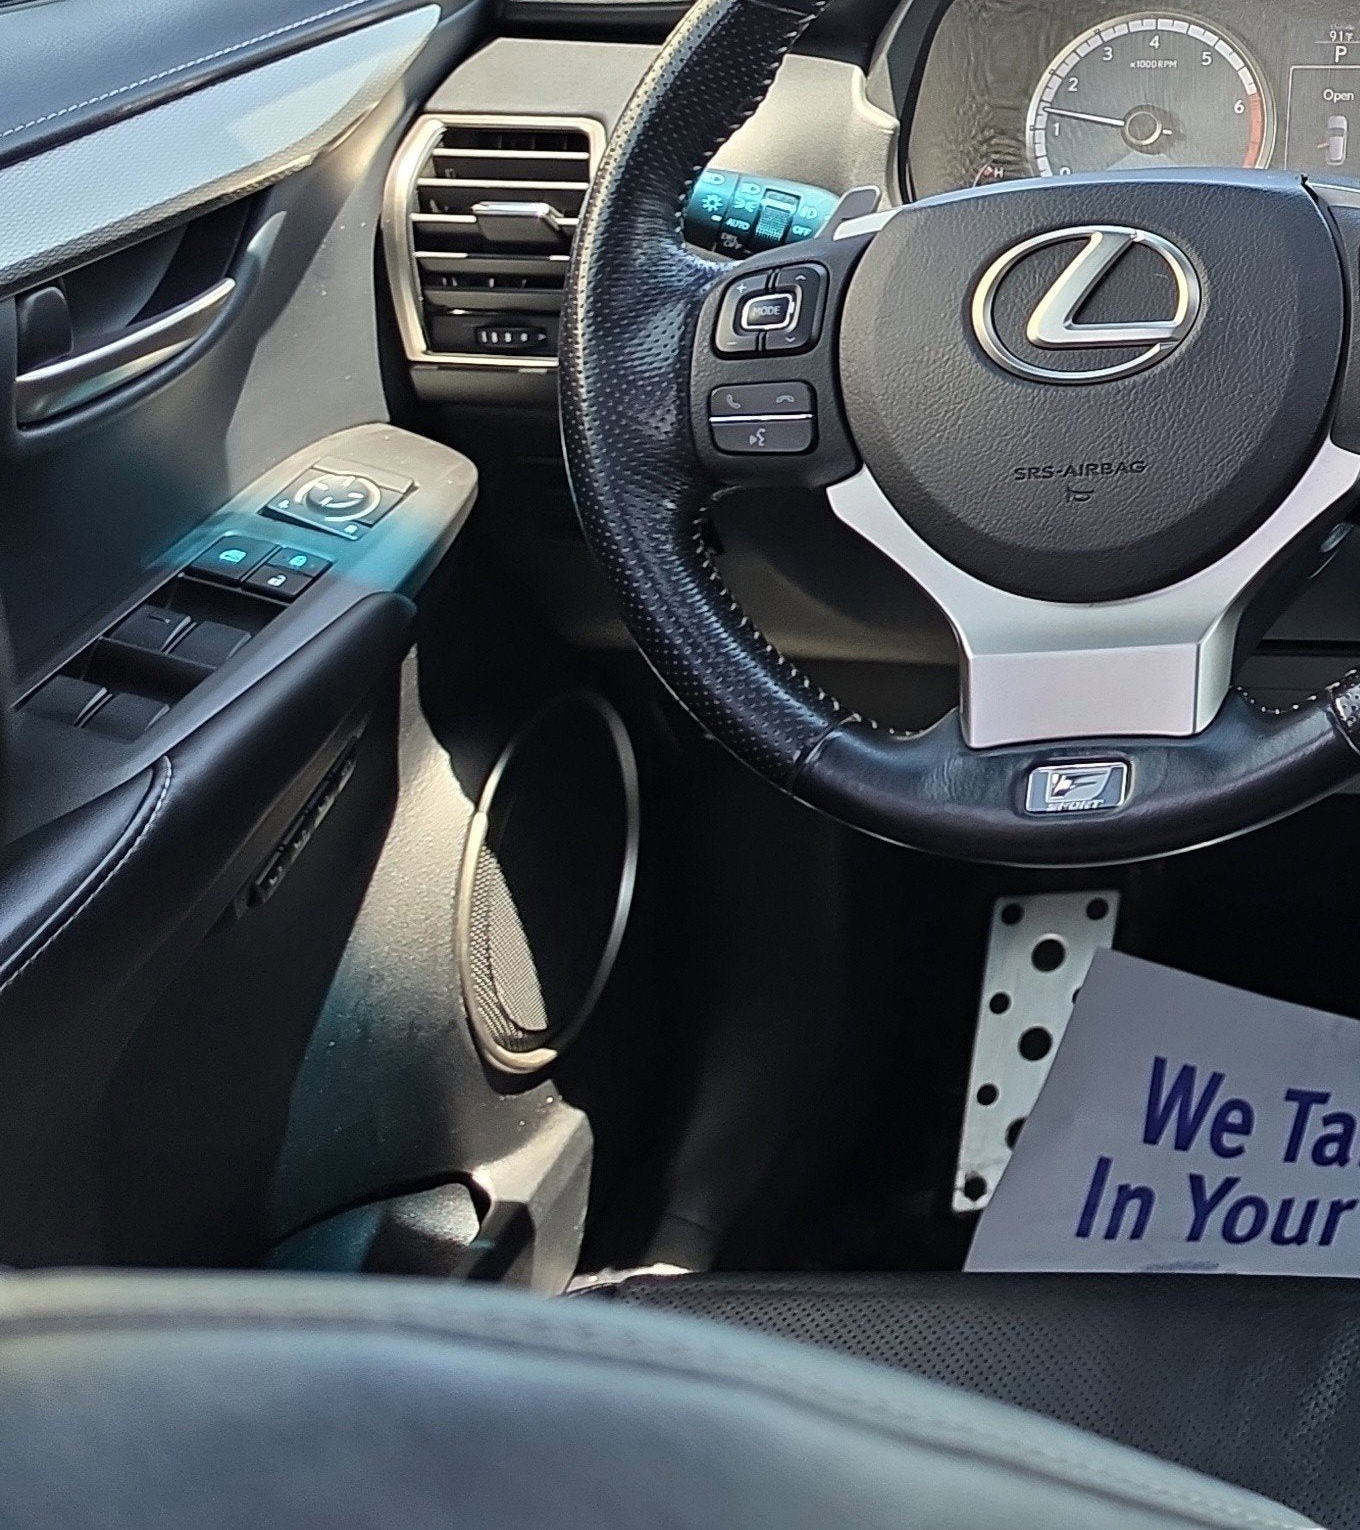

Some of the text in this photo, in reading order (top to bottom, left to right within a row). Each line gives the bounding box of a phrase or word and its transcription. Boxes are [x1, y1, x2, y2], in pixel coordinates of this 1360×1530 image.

[1149, 35, 1160, 50] 4
[1102, 47, 1113, 61] 3
[1200, 51, 1213, 66] 5
[1335, 45, 1347, 63] P
[1068, 77, 1079, 92] 2
[1323, 89, 1355, 103] Open
[1233, 99, 1245, 114] 6
[1053, 122, 1061, 137] 1
[993, 167, 1004, 178] H
[725, 218, 750, 231] AUTO
[792, 226, 813, 237] OFF
[752, 305, 781, 316] MODE
[1014, 459, 1147, 482] SRS-AIRBAG
[1141, 1056, 1255, 1158] We
[1074, 1156, 1157, 1242] In
[1184, 1173, 1357, 1248] Your
